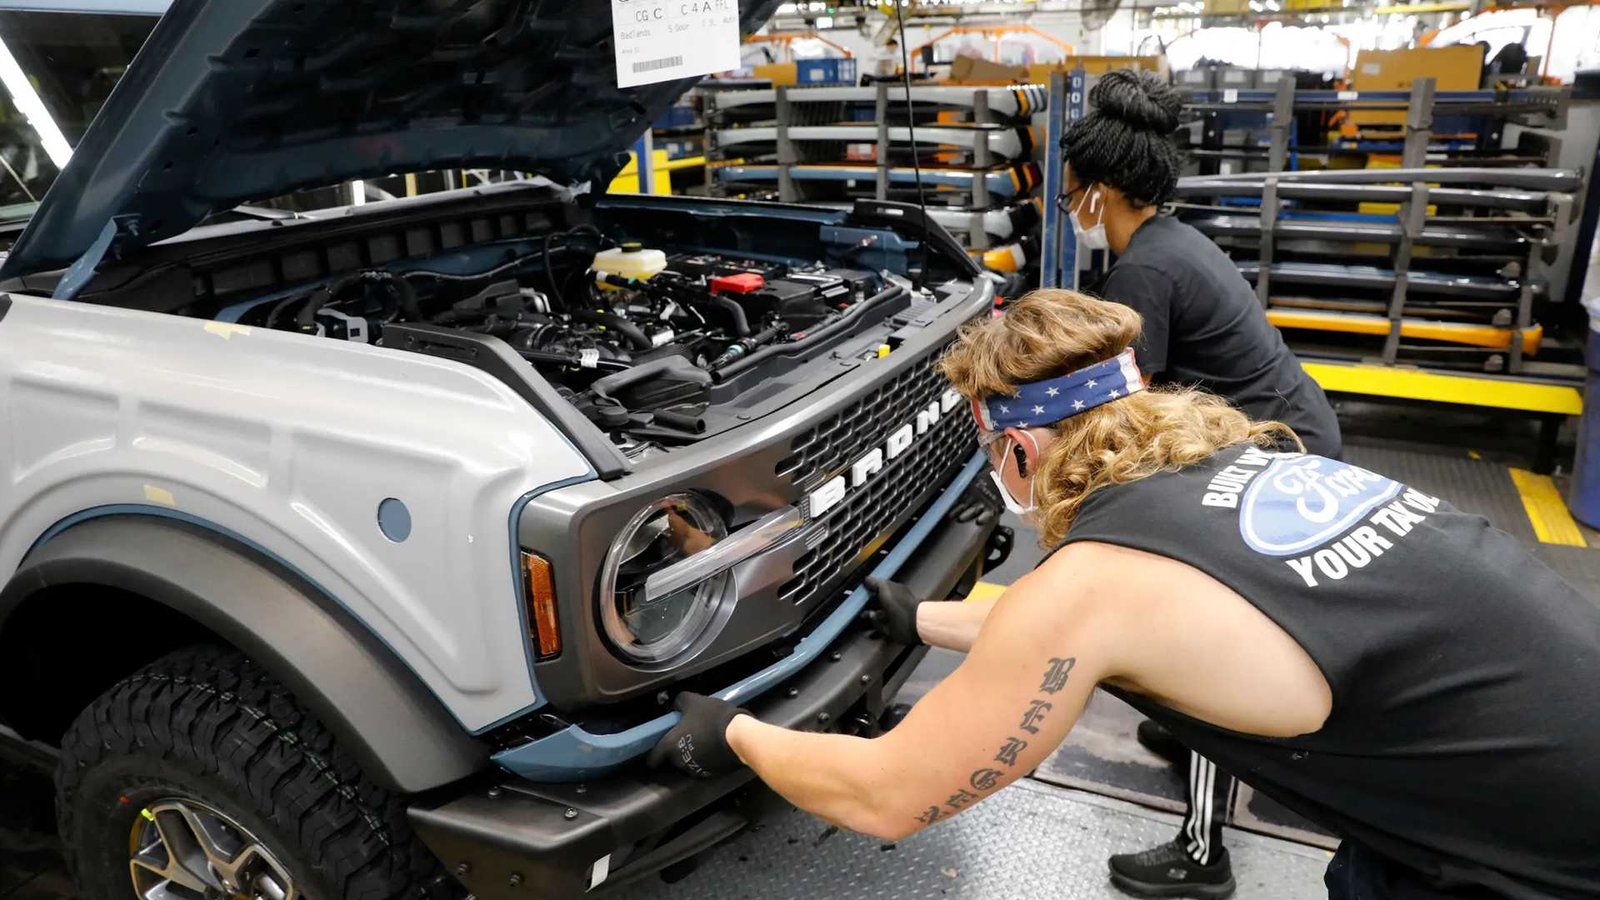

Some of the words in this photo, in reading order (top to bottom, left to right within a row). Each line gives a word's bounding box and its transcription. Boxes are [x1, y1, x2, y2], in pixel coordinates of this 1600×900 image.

[702, 1, 712, 13] A
[809, 387, 962, 518] BRONC
[1201, 464, 1259, 509] BUILT
[1285, 525, 1394, 588] YOUR
[1369, 500, 1426, 537] TAX
